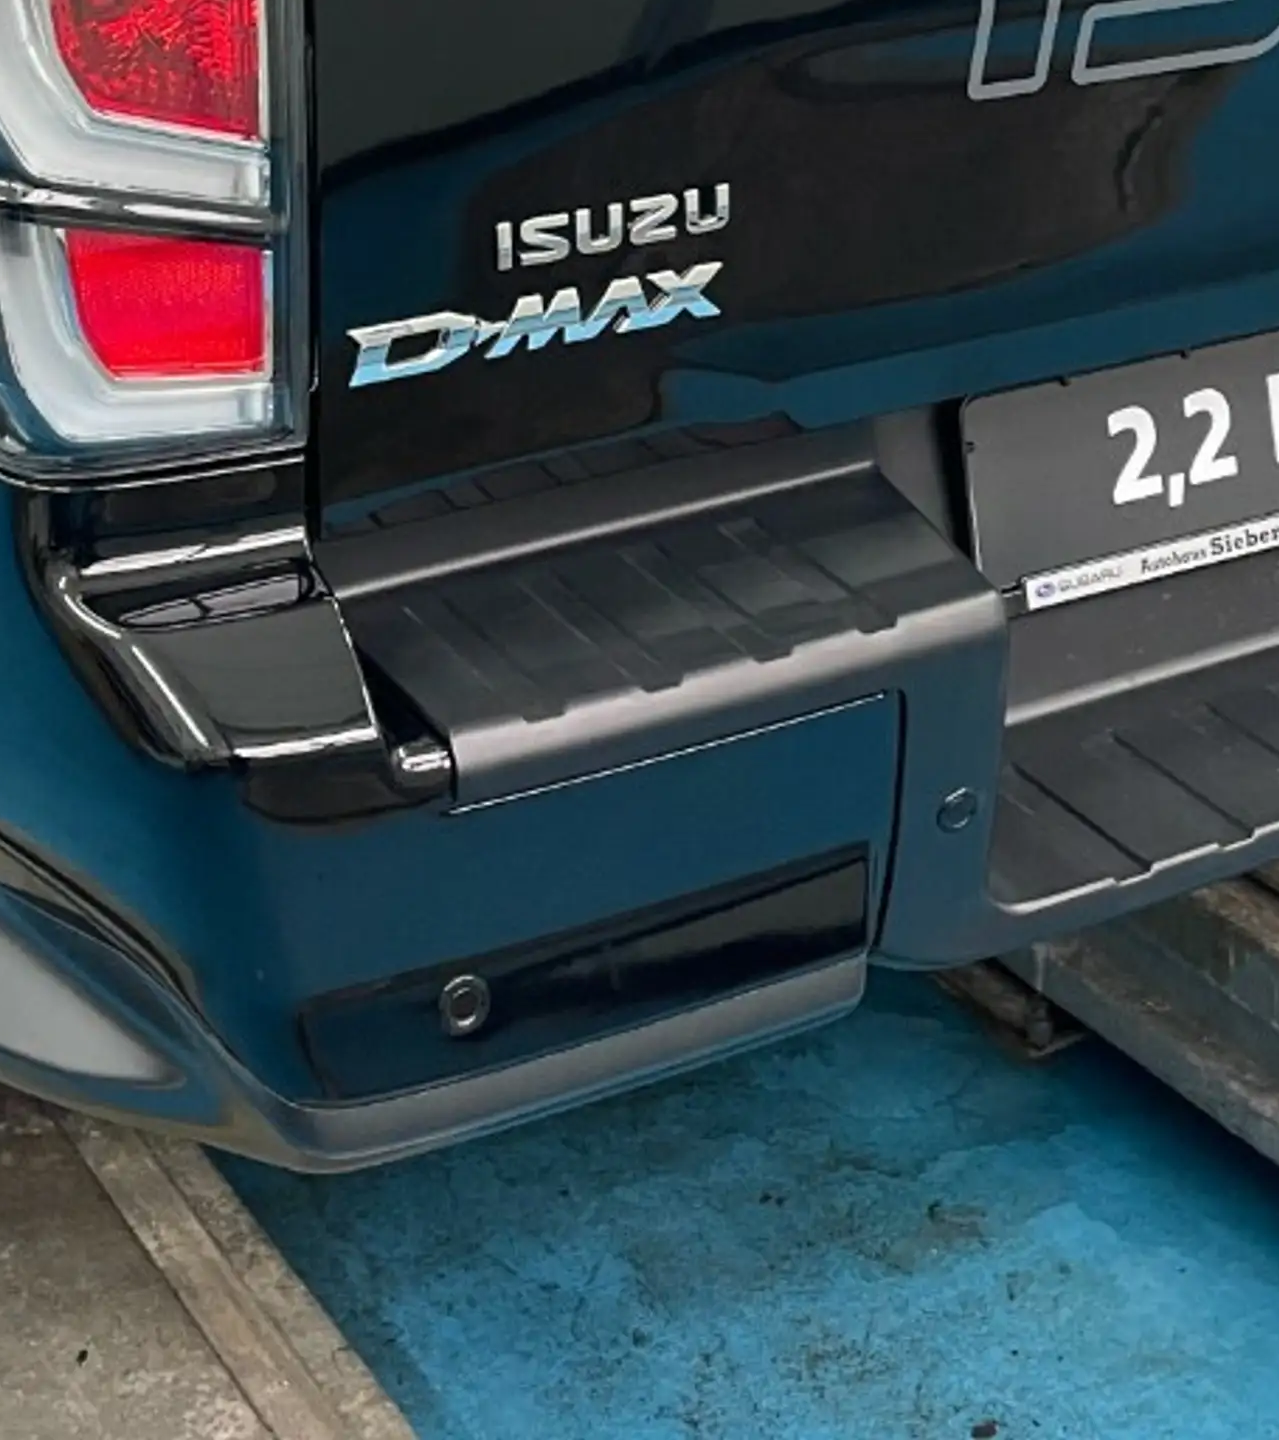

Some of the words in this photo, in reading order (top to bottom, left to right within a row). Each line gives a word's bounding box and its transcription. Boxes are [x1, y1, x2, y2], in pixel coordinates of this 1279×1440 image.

[496, 182, 730, 271] ISUZU
[346, 260, 723, 388] D-MAX
[1106, 388, 1239, 507] 2,2
